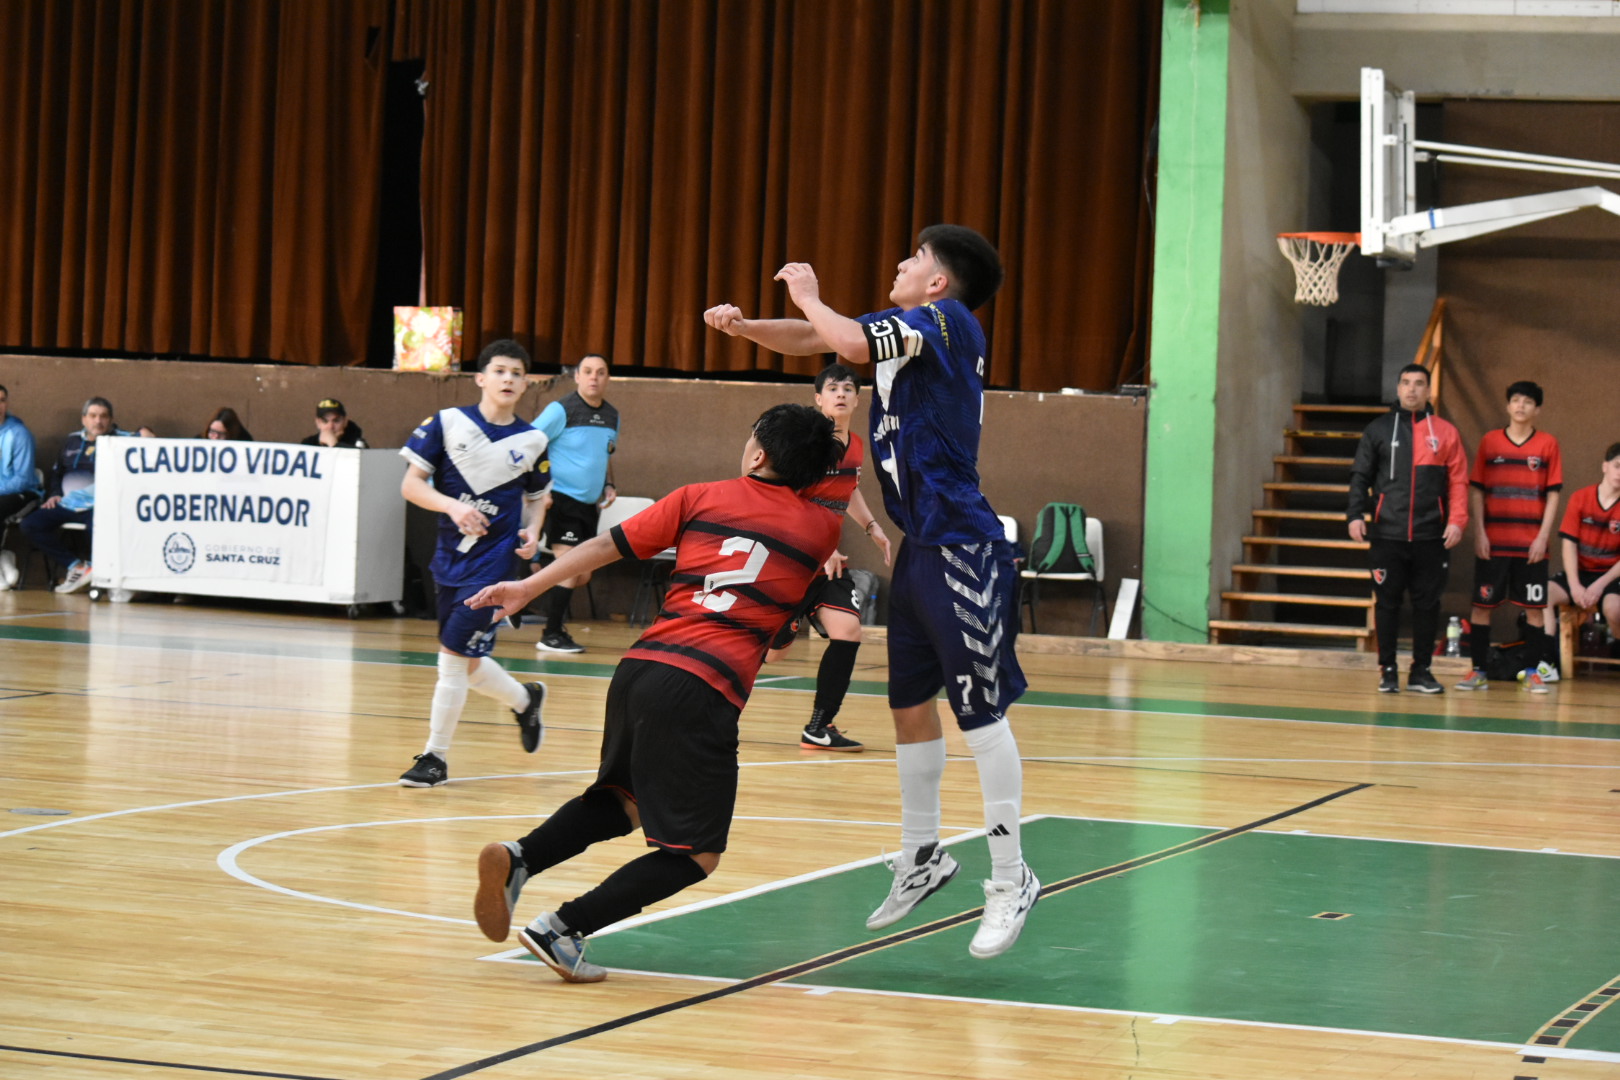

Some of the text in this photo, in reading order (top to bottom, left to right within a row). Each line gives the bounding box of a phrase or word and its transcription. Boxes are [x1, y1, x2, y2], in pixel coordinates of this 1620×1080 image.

[125, 446, 323, 479] CLAUDIO VIDAL
[136, 494, 310, 527] GOBERNADOR
[204, 544, 281, 555] GOBIERNO DE
[206, 553, 281, 565] SANTA CRUZ
[690, 535, 770, 613] 2
[1525, 583, 1543, 602] 10
[956, 674, 973, 704] 7
